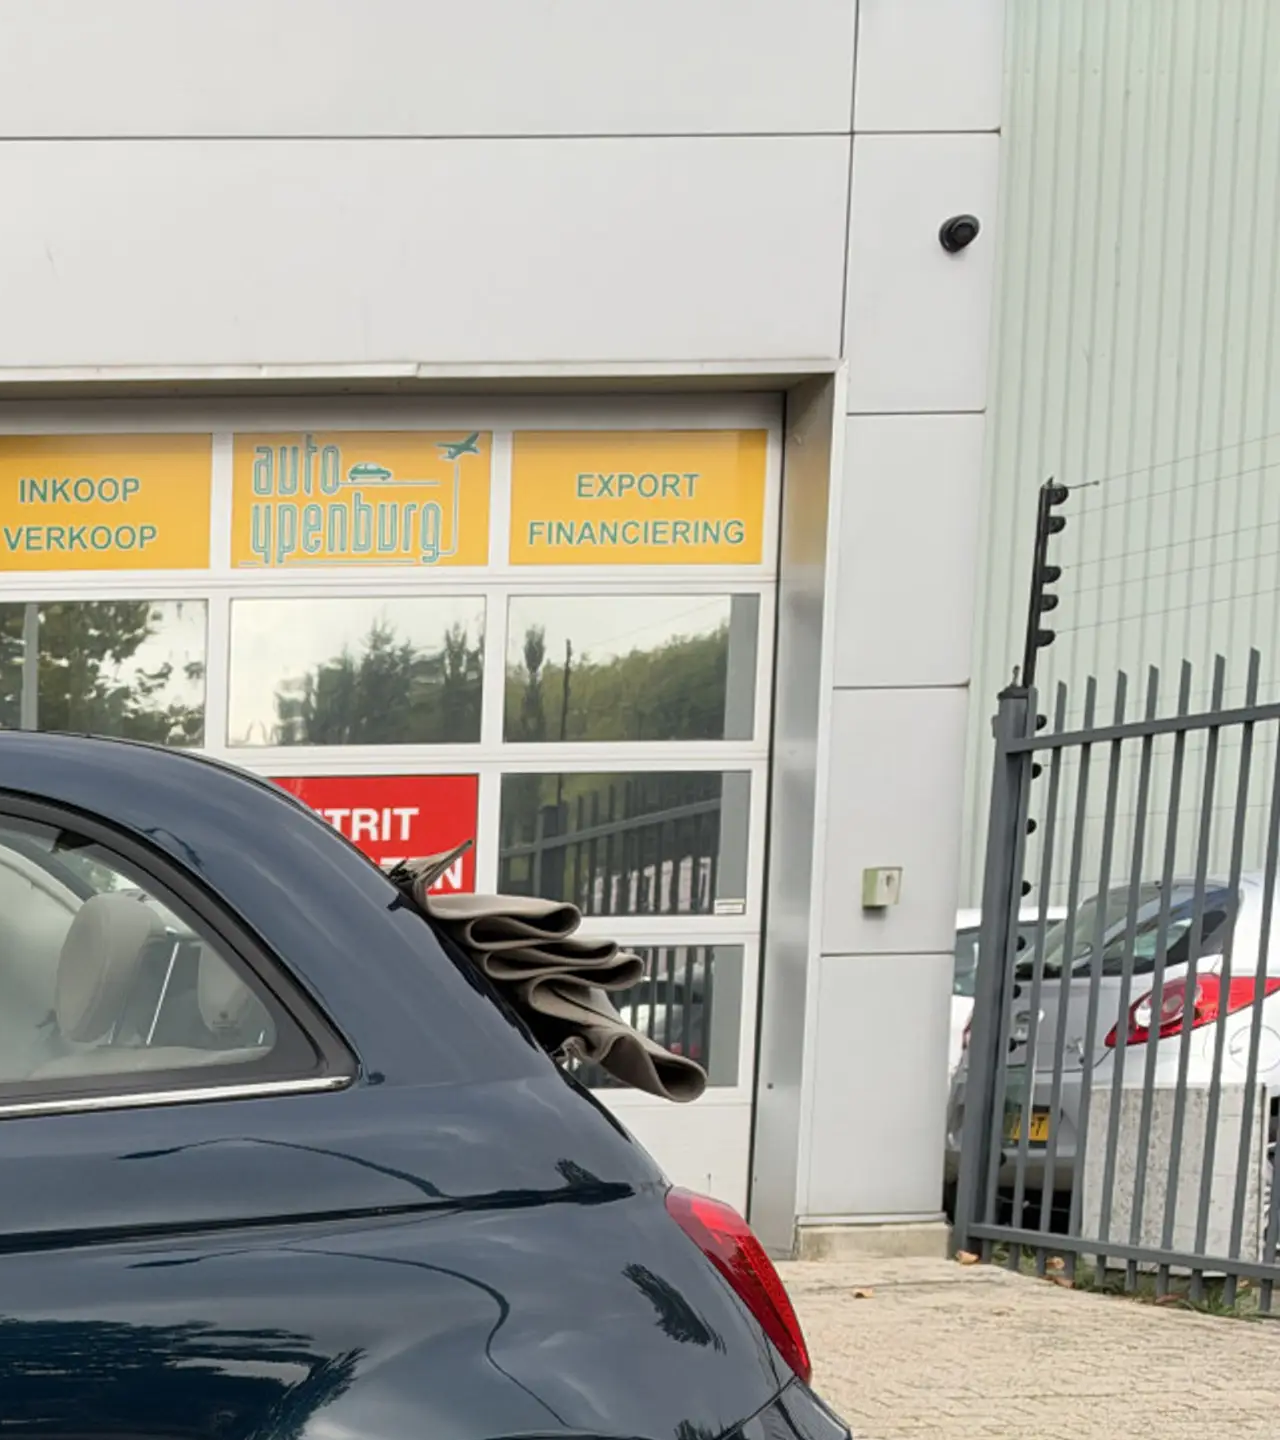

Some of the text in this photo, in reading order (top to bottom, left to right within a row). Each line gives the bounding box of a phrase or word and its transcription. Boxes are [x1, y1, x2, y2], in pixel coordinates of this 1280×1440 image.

[252, 434, 340, 496] auto
[18, 478, 141, 503] INKOOP
[576, 473, 700, 498] EXPORT
[3, 525, 157, 552] VERKOOP
[251, 492, 442, 564] ypenburg
[528, 519, 745, 546] FINANCIERING
